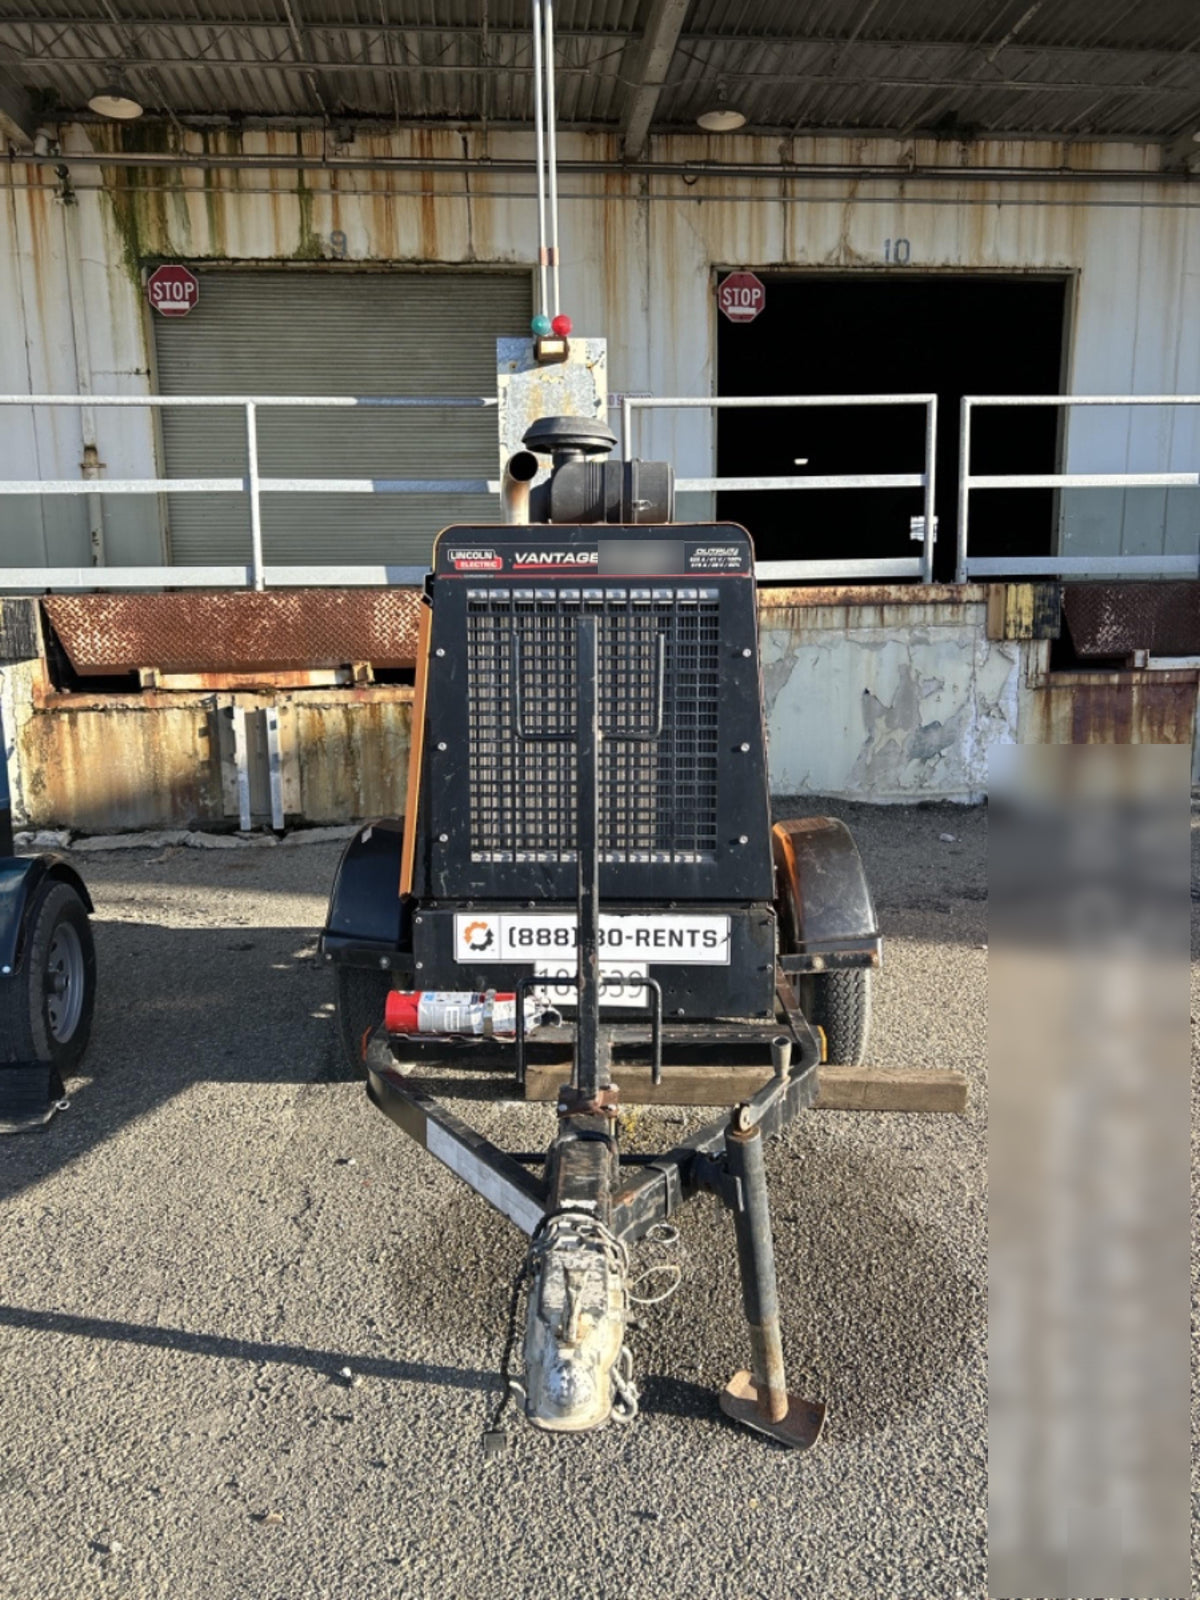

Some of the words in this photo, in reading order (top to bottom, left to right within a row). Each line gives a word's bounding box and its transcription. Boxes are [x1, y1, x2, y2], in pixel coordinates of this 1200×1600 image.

[330, 230, 347, 258] 9
[884, 238, 910, 265] 10
[153, 281, 194, 300] STOP
[723, 288, 761, 306] STOP
[450, 551, 492, 560] LINCOLN
[460, 560, 497, 568] ELECTRIC
[514, 552, 598, 564] VANTAGE
